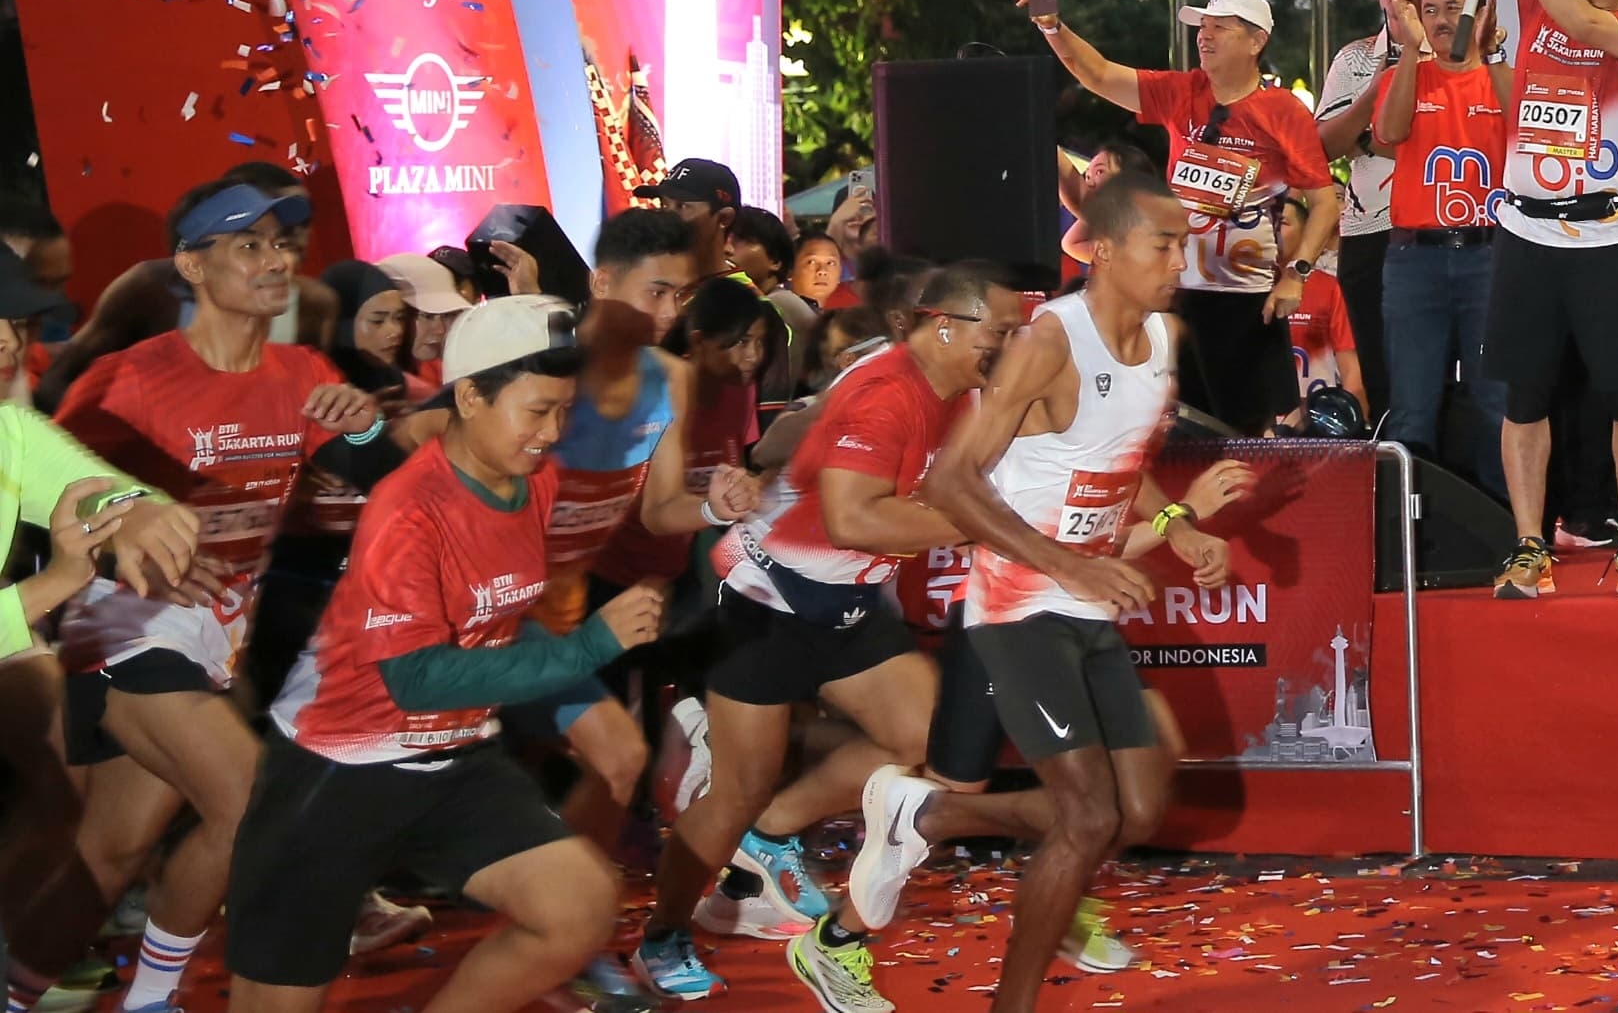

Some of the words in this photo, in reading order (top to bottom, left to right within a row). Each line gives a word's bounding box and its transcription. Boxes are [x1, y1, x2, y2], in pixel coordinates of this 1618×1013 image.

[1583, 49, 1605, 59] RUN
[410, 88, 453, 116] MINI
[1521, 104, 1583, 126] 20507
[1233, 137, 1255, 147] RUN
[1552, 148, 1578, 157] MASTER
[1588, 137, 1598, 159] HALF
[367, 165, 442, 195] PLAZA
[443, 164, 496, 194] MINI
[1177, 166, 1236, 192] 40165
[218, 423, 240, 435] BTN
[218, 435, 275, 452] JAKARTA
[277, 432, 302, 447] RUN
[492, 573, 513, 587] BTN
[1165, 583, 1268, 626] RUN
[365, 608, 414, 630] League
[1158, 646, 1258, 665] INDONESIA
